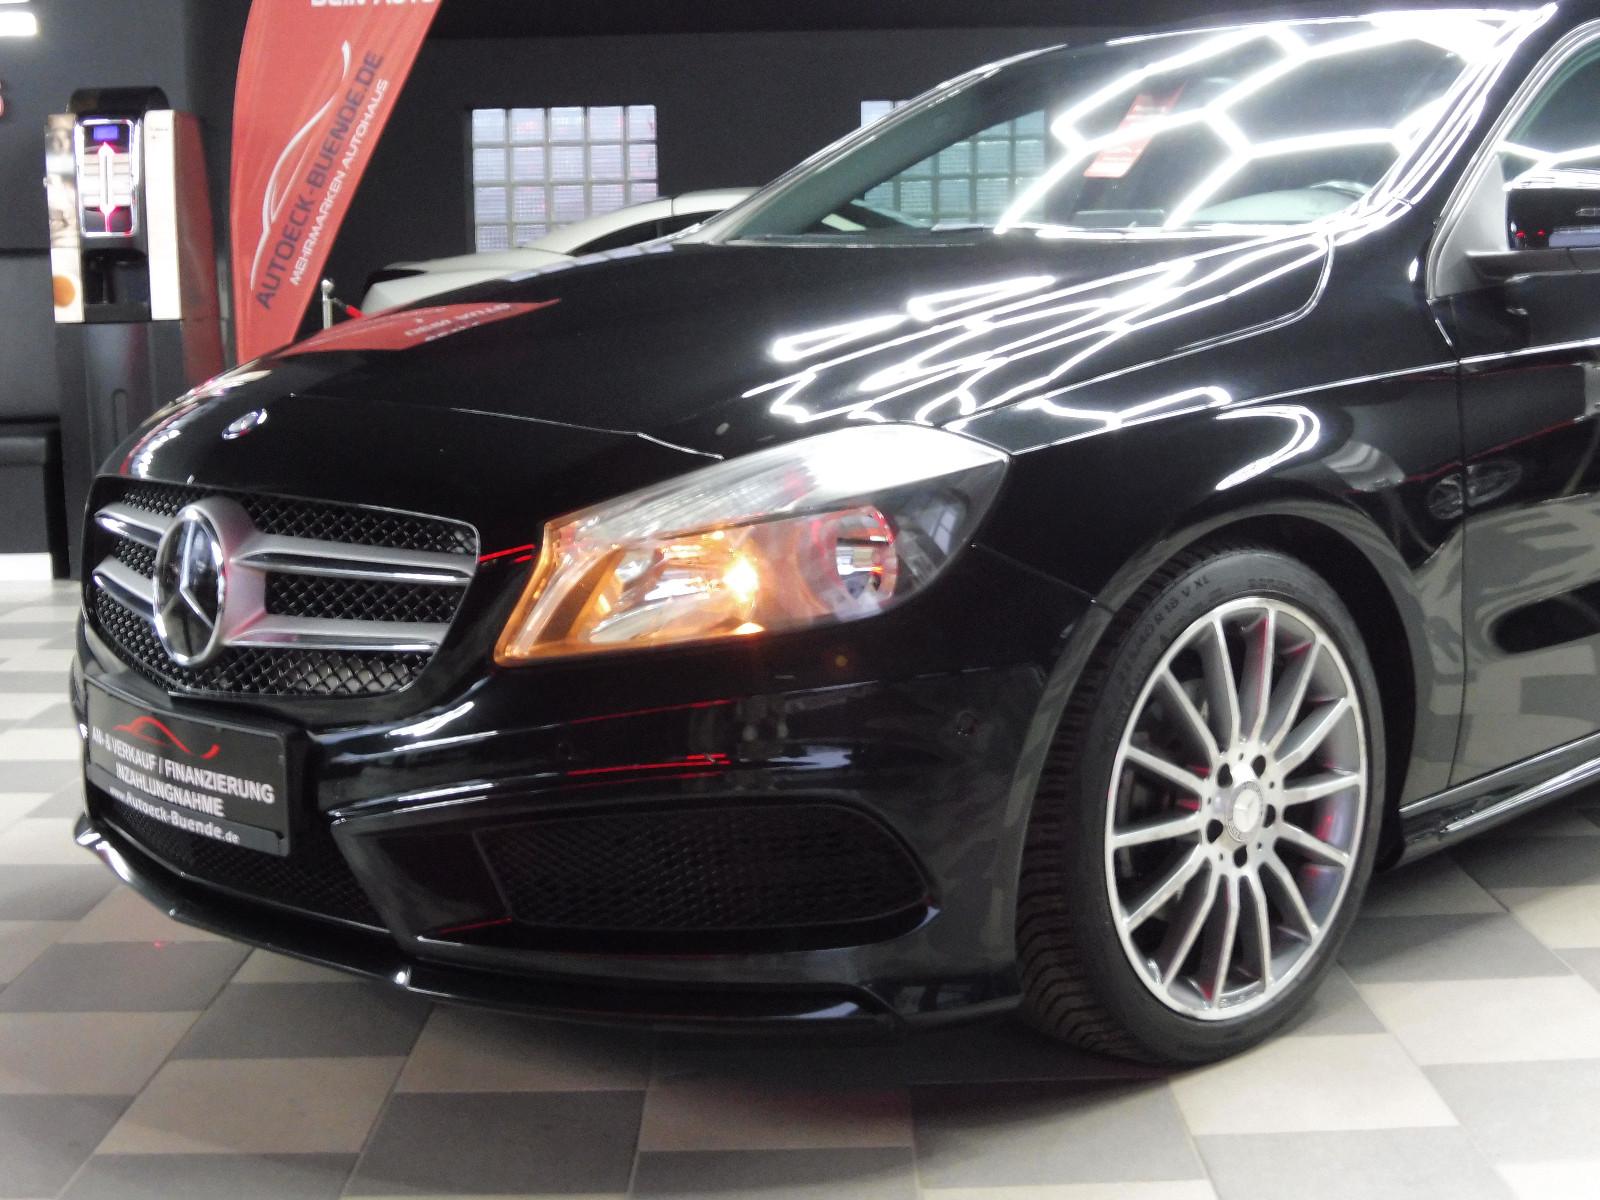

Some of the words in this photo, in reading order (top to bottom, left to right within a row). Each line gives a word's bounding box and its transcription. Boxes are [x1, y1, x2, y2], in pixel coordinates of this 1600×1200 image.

[256, 51, 385, 310] AUTOECK-BUENDE.DE
[289, 170, 347, 286] MEHRMARKEN
[341, 78, 390, 169] AUTOHAUS
[112, 736, 158, 771] VERKAUF
[164, 758, 275, 804] FINANZIERUNG
[115, 761, 225, 817] INZAHLUNGNAHME
